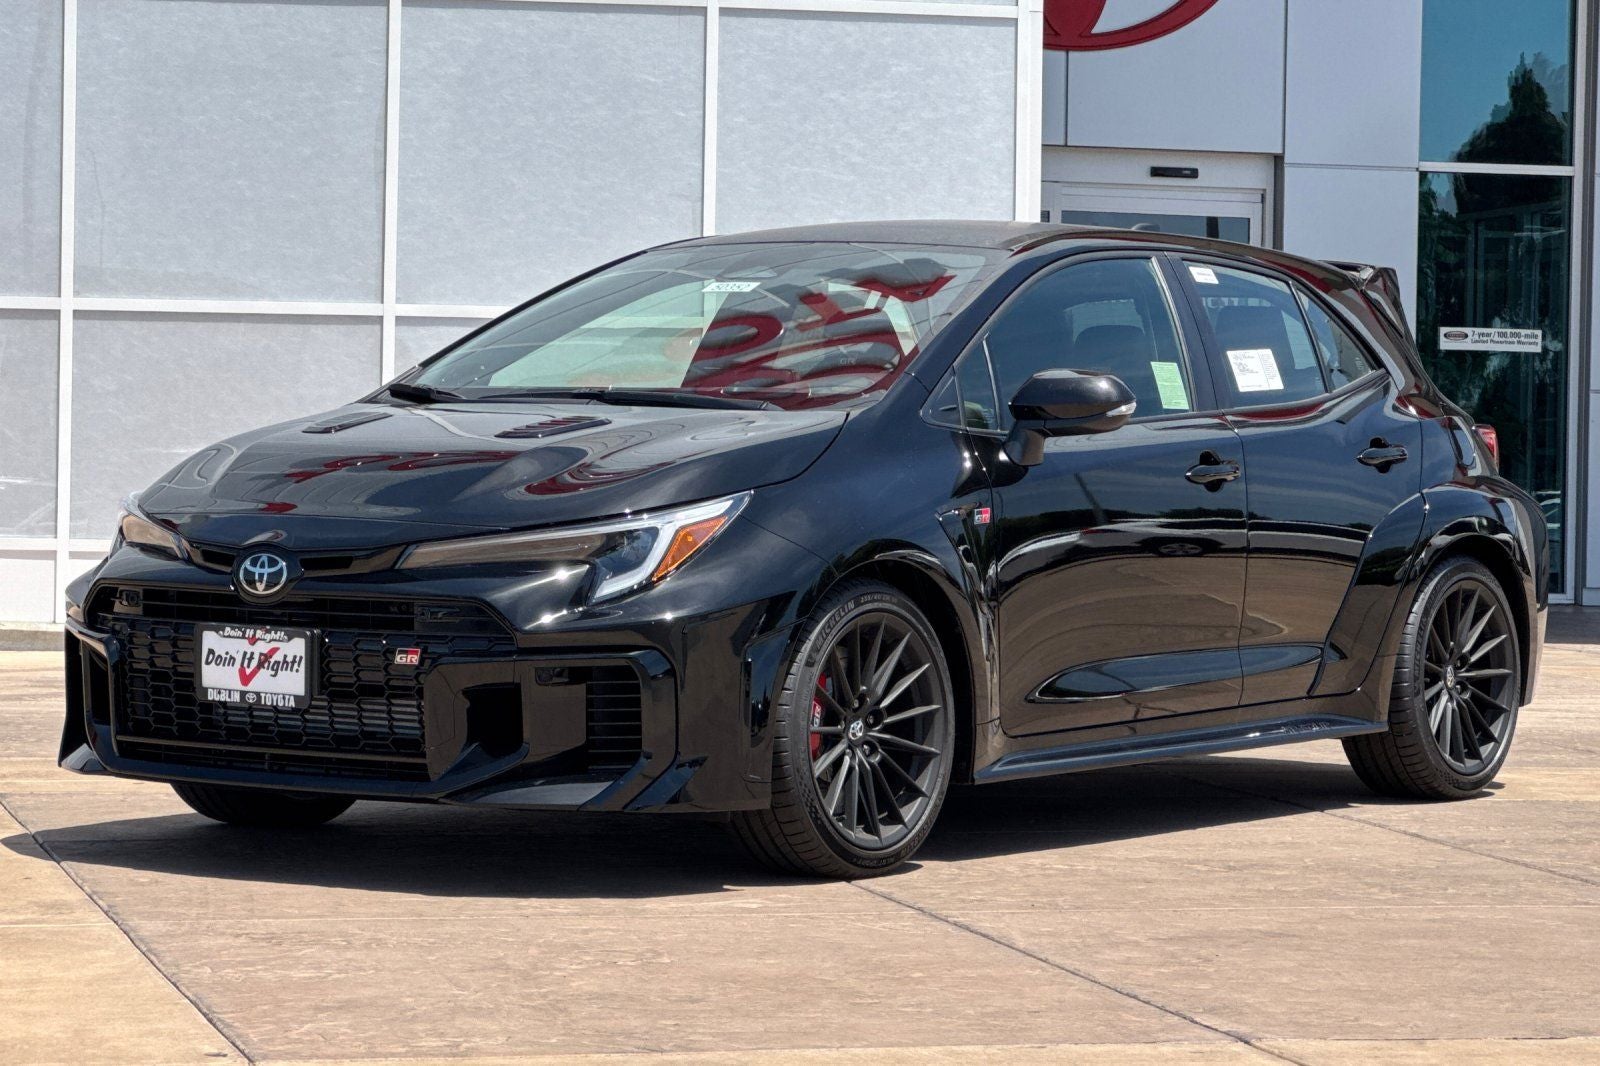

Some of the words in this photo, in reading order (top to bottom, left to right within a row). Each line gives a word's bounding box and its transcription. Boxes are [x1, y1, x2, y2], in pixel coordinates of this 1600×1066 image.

[223, 626, 245, 637] Doin'
[245, 628, 255, 638] It
[255, 629, 285, 643] Right!
[814, 599, 856, 650] MICHELIN
[204, 648, 240, 668] Doin'
[240, 650, 255, 669] It
[257, 651, 304, 678] Right!
[396, 653, 419, 664] GR
[207, 688, 241, 703] DUBLIN
[259, 692, 296, 708] TOYOTA
